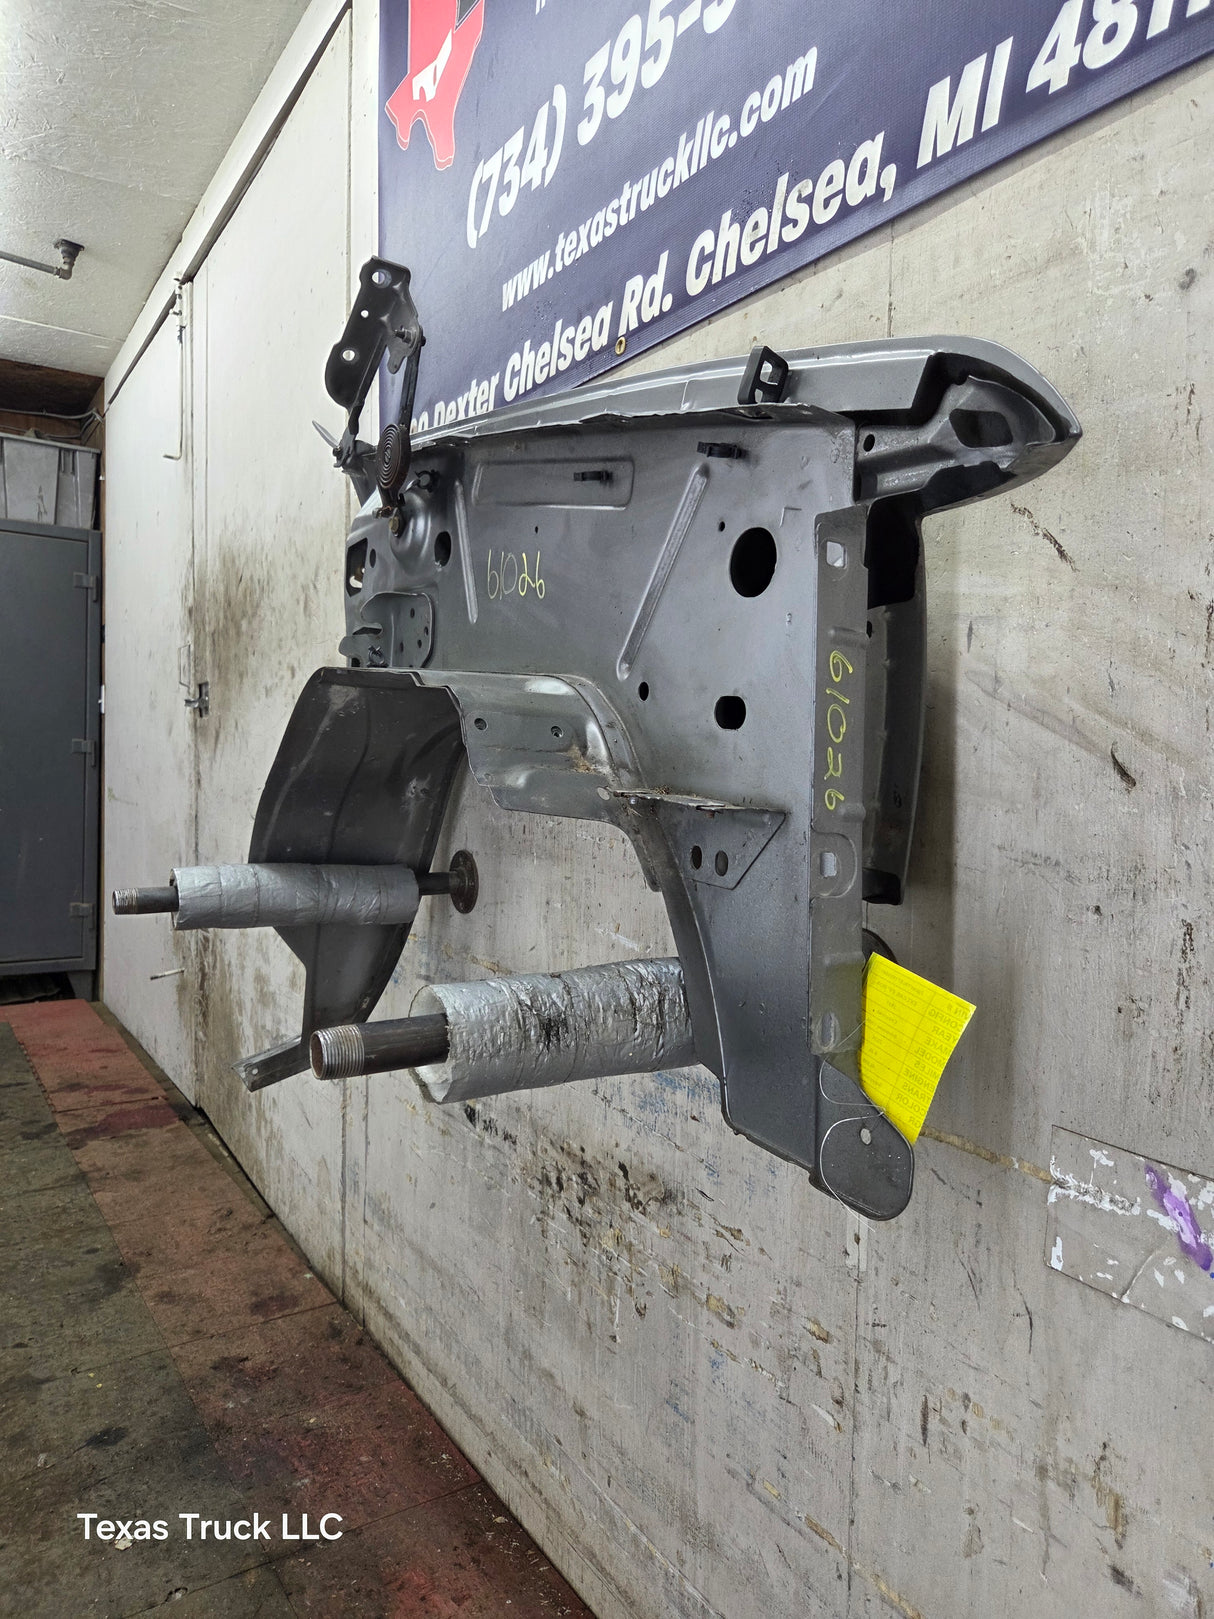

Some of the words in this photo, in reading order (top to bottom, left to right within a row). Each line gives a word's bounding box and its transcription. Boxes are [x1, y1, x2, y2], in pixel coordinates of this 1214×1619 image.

[433, 371, 500, 428] Dexter
[504, 300, 614, 402] Chelsea
[617, 250, 673, 338] Rd.
[685, 130, 897, 297] Chelsea,
[916, 36, 1014, 169] MI
[467, 84, 567, 249] (734)
[501, 46, 818, 312] www.texastruckllc.com
[487, 548, 545, 600] 61026
[824, 650, 854, 811] 61026
